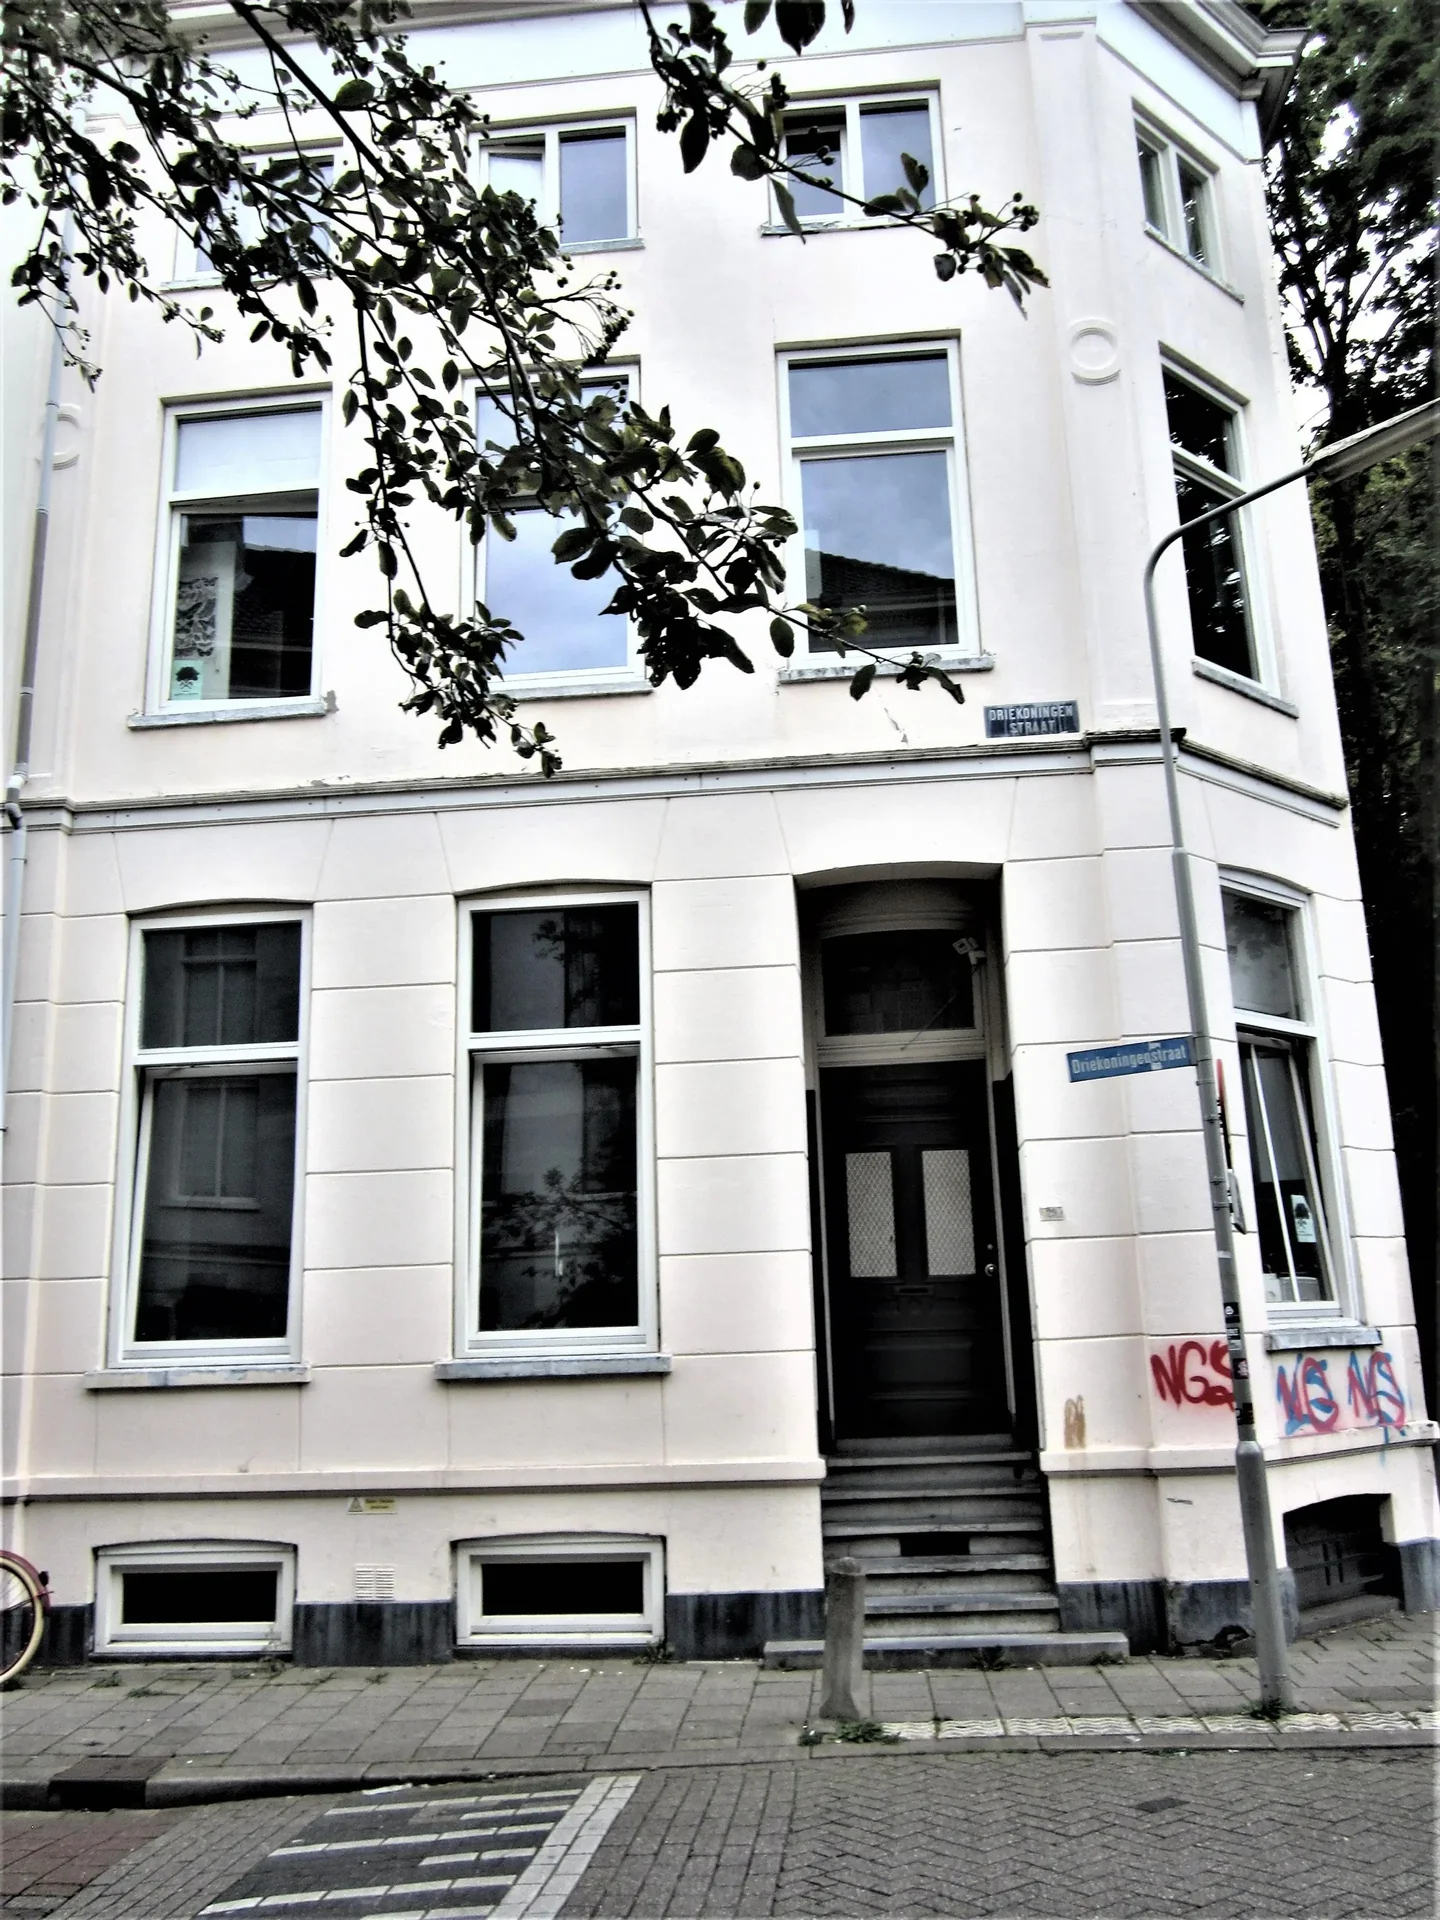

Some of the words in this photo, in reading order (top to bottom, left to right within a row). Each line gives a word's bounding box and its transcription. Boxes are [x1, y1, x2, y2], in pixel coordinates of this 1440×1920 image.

[988, 705, 1073, 721] DRIEKONINGEN
[1009, 720, 1056, 735] STRAAT
[1071, 1045, 1187, 1074] Driekoningenstraat
